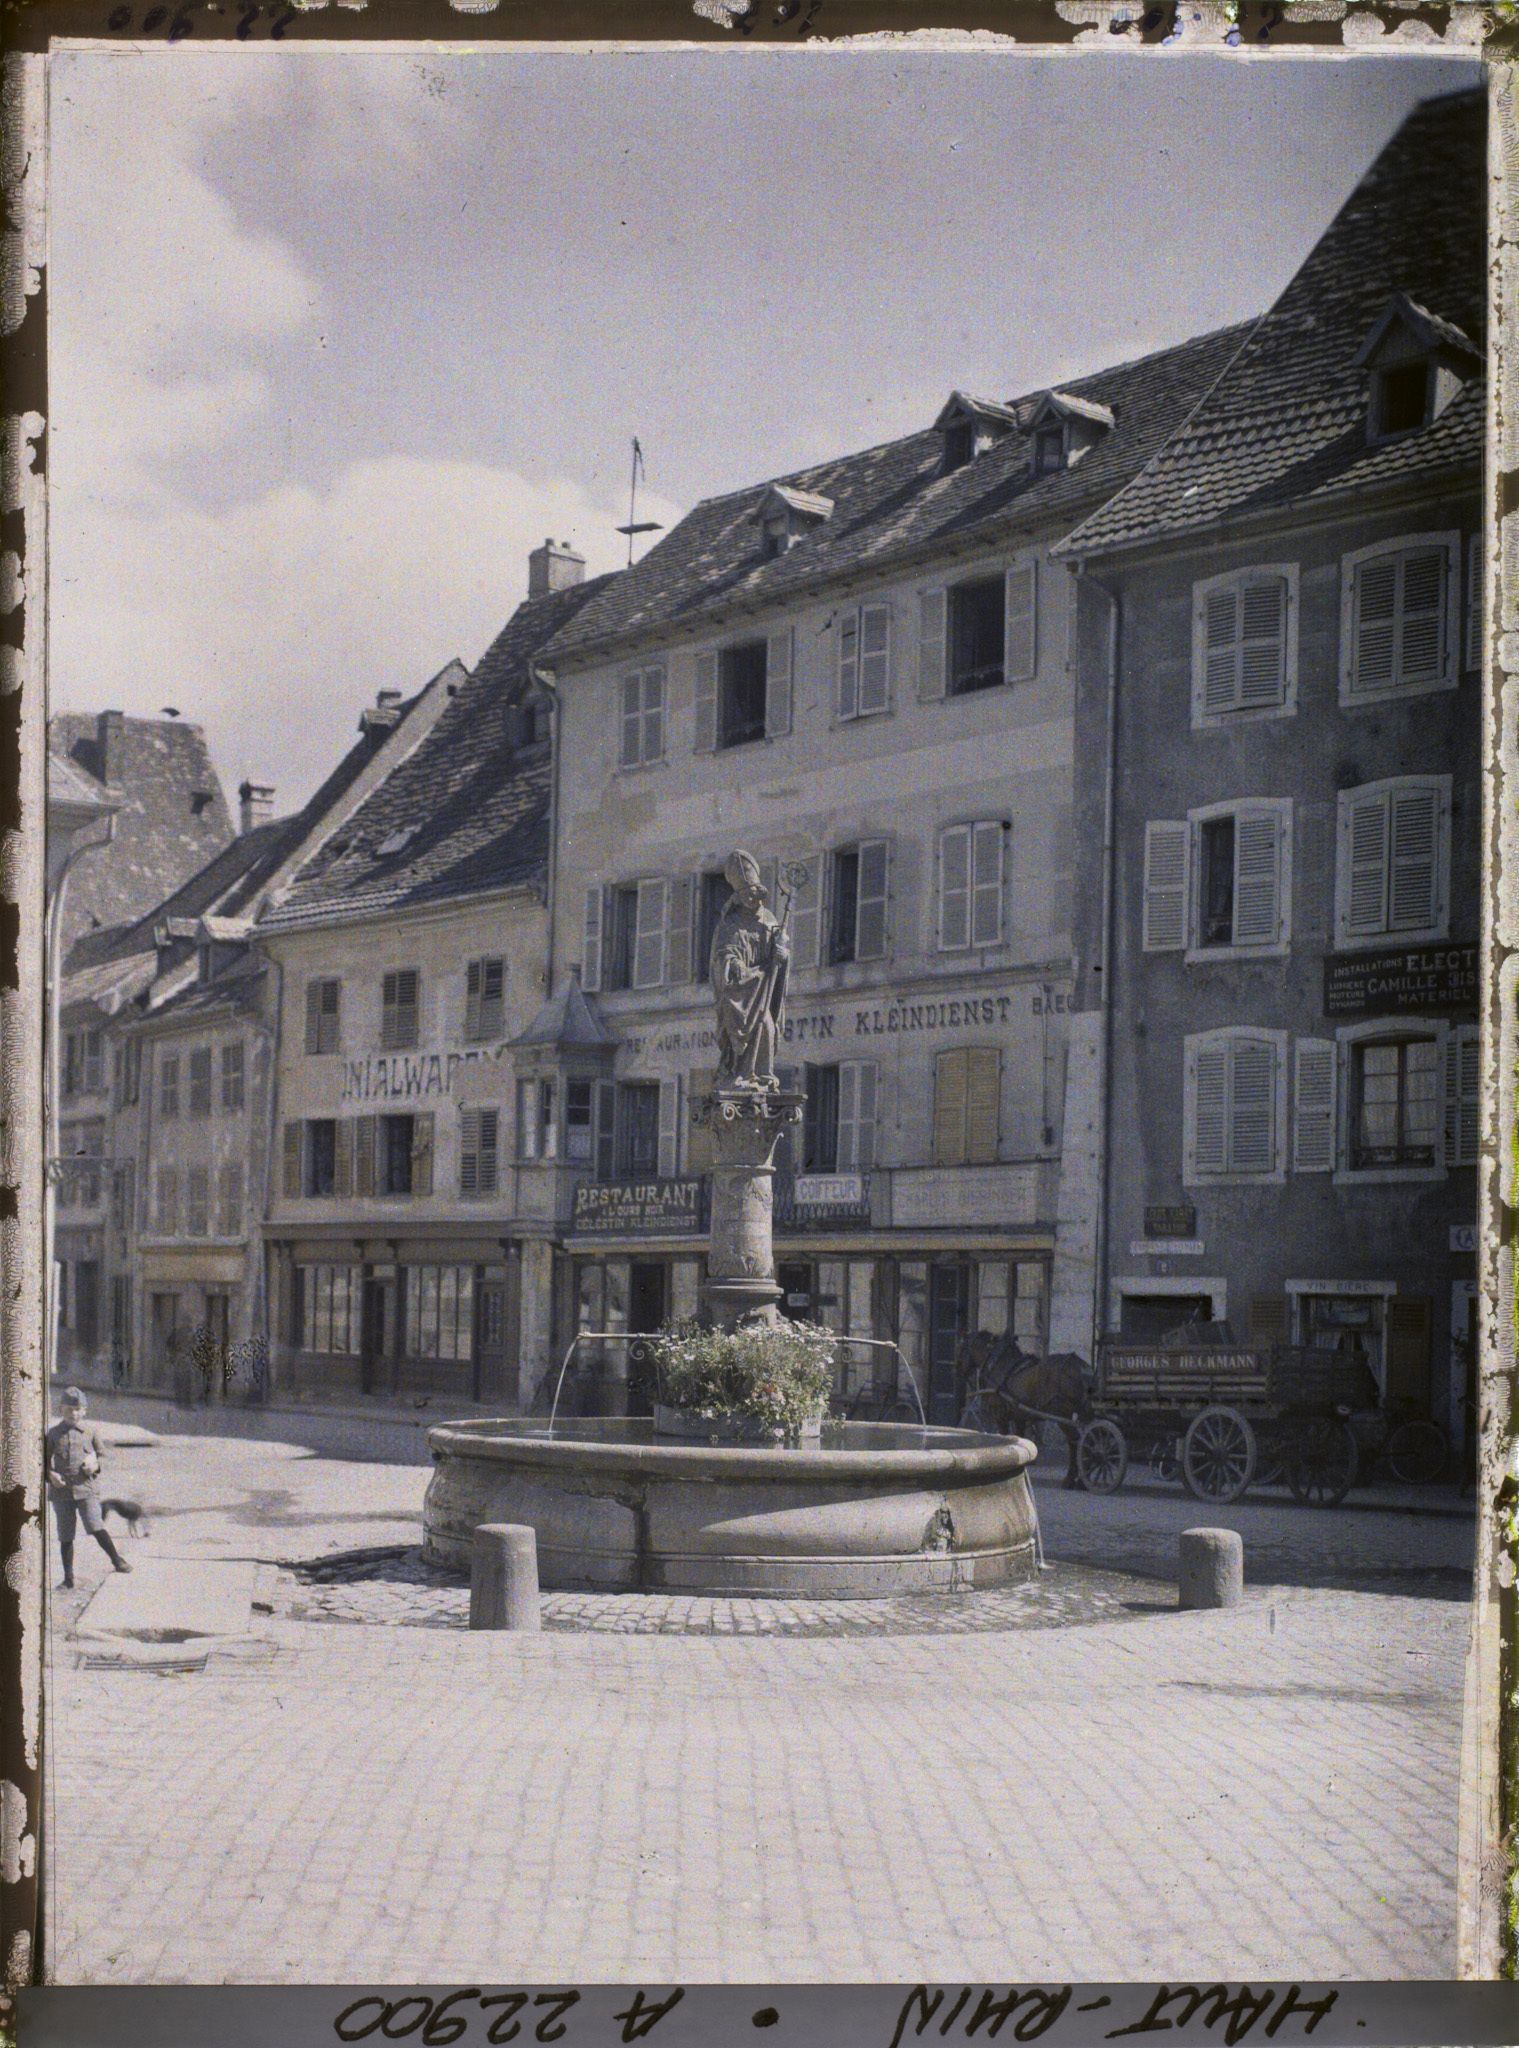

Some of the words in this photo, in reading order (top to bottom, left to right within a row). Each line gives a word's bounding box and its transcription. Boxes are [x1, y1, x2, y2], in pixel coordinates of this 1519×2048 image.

[1367, 974, 1438, 994] CAMILLE
[854, 996, 1012, 1035] KLEINDIENST
[575, 1182, 699, 1214] RESTAURANT
[333, 1988, 580, 2046] 22900
